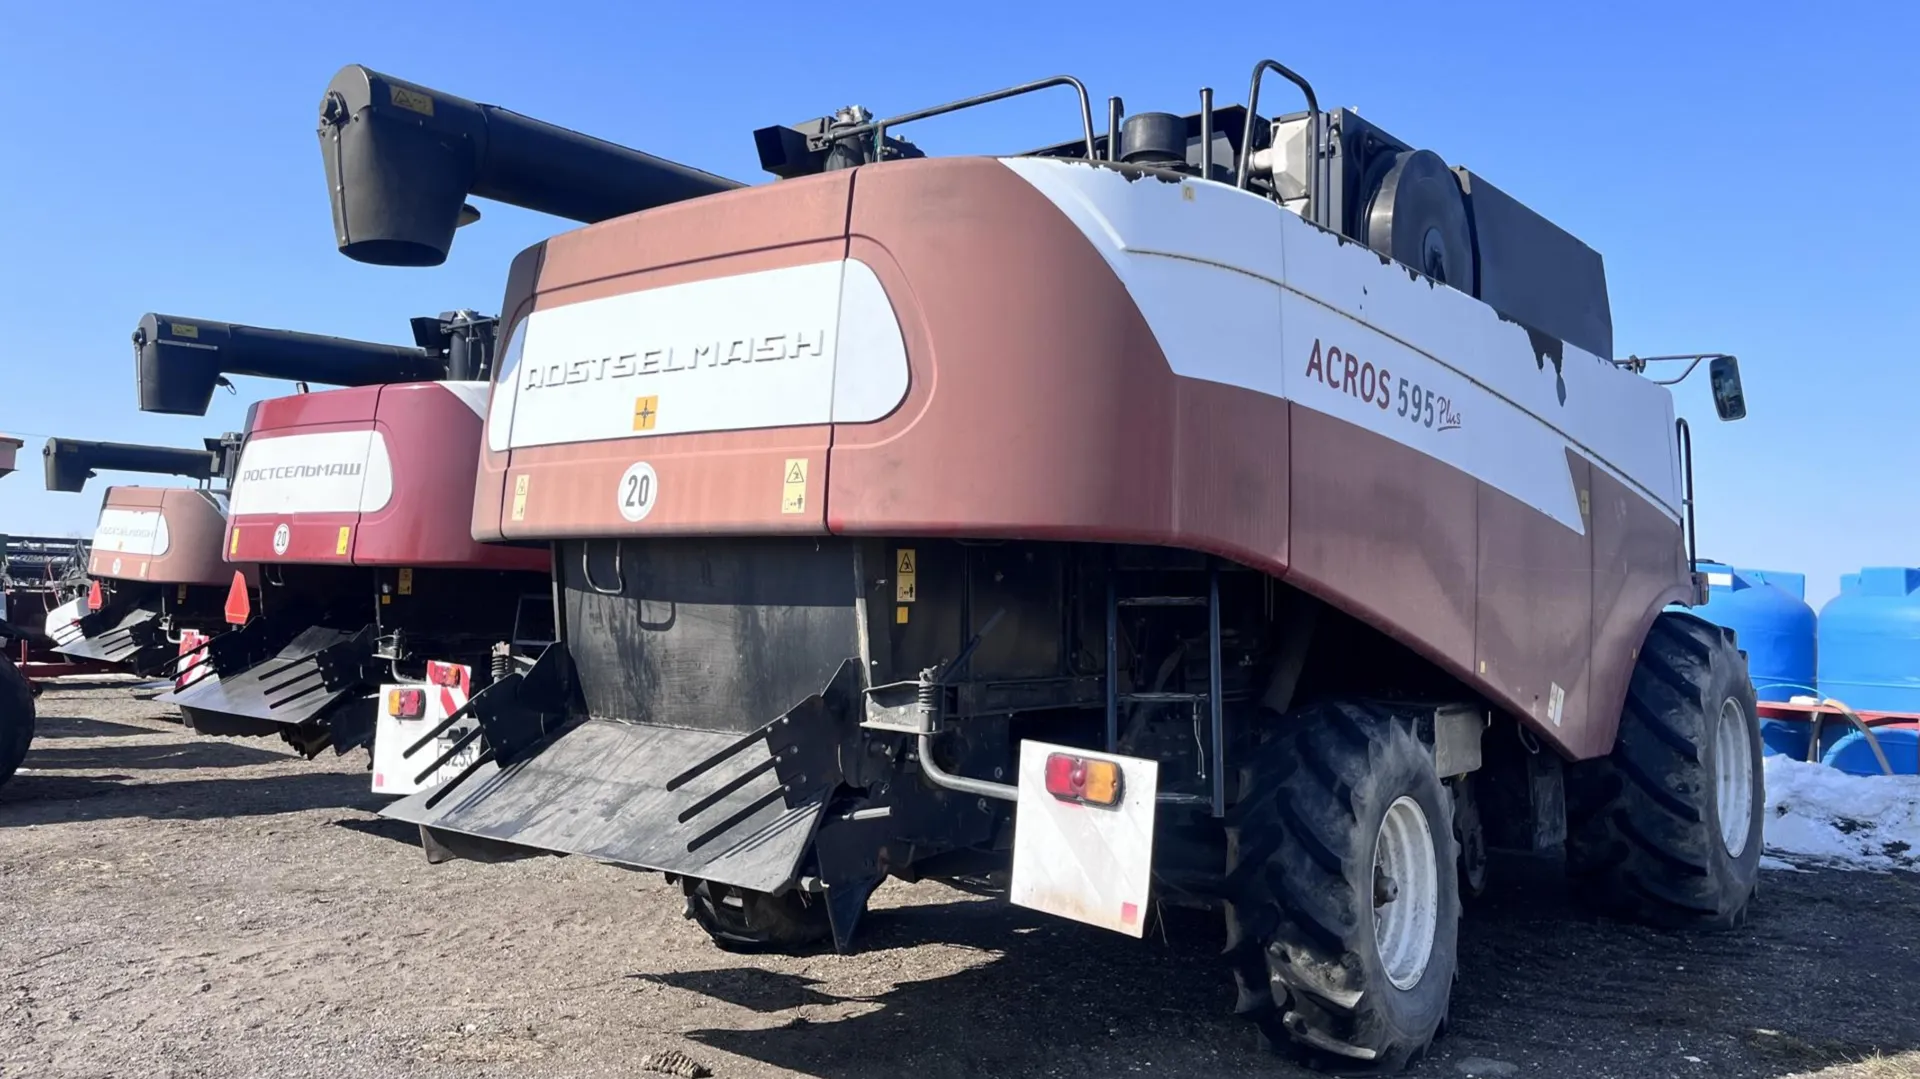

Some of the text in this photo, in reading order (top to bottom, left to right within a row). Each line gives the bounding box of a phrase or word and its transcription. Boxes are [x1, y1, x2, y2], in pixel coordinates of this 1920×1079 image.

[1306, 338, 1462, 431] ACROS 595 Plus
[243, 462, 361, 483] РОСТСЕЛЬМАШ
[625, 474, 650, 507] 20
[276, 531, 287, 547] 20
